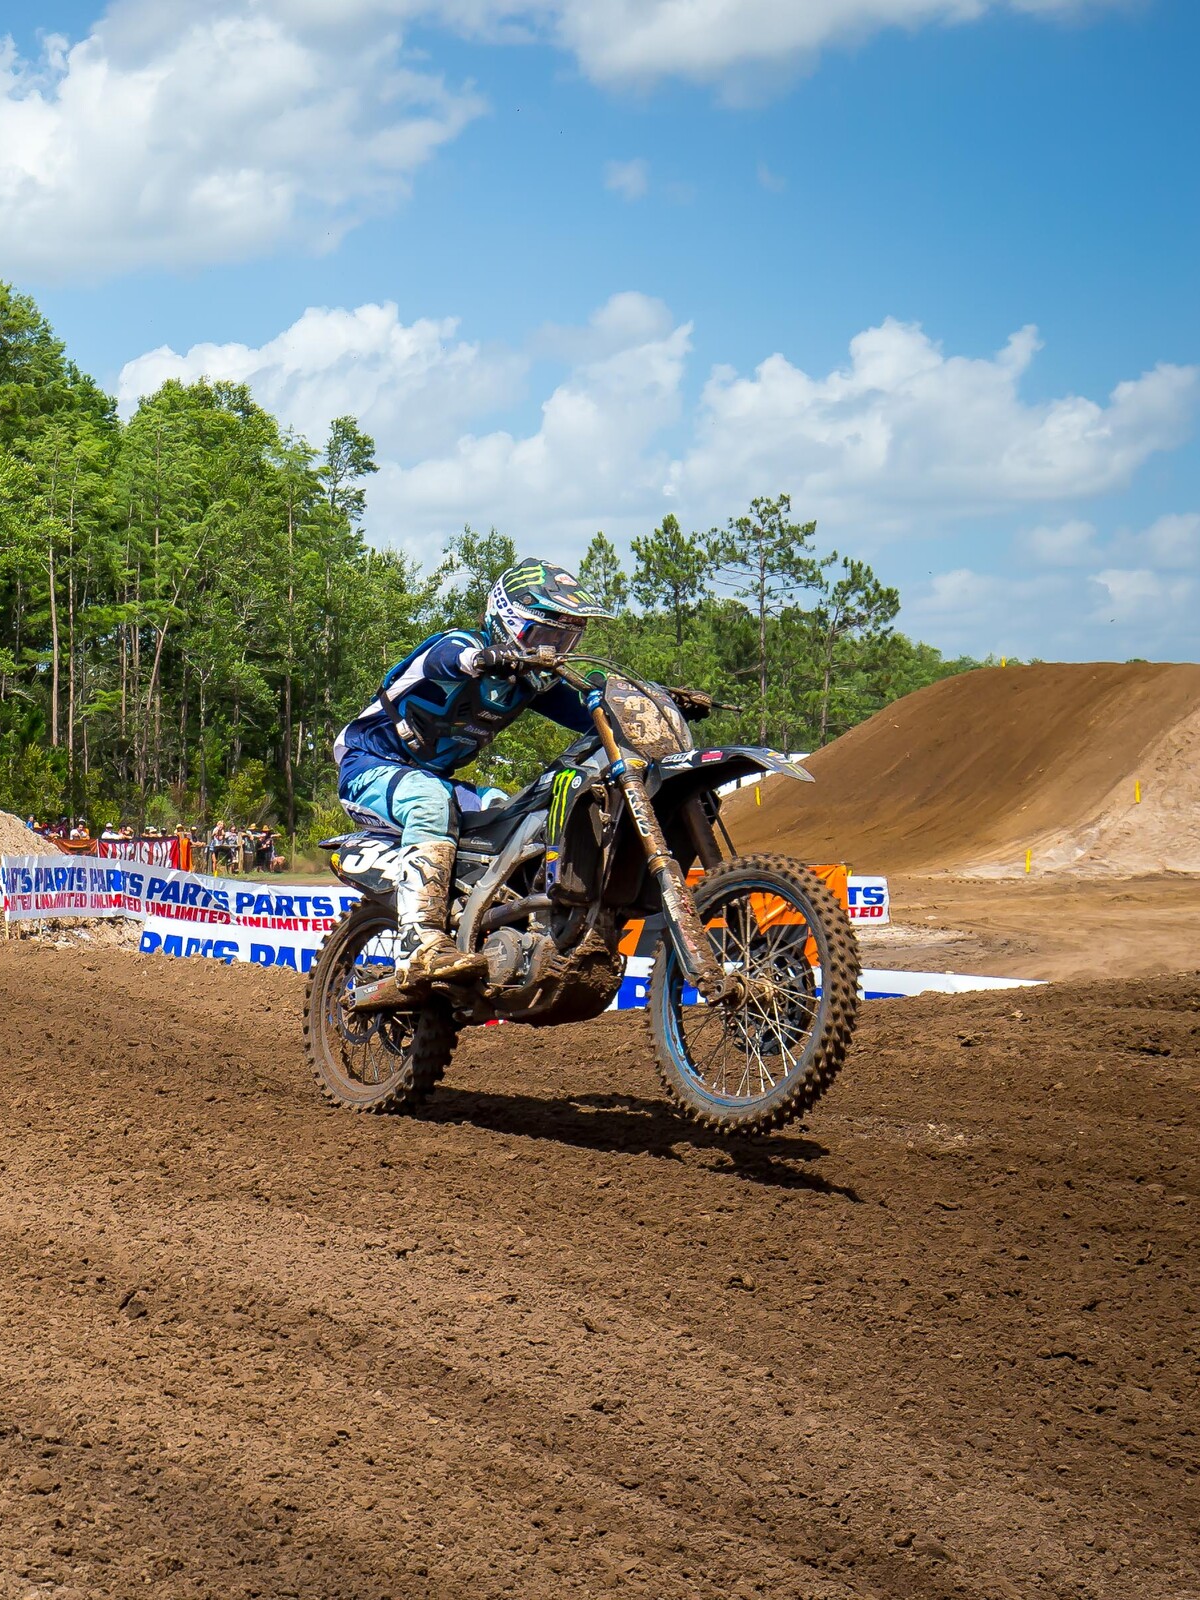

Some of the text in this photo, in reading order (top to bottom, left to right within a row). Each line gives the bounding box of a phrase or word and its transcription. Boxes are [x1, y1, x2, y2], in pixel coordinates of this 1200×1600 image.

[35, 867, 87, 893] PARTS
[89, 867, 144, 898] PARTS
[146, 877, 230, 912] PARTS
[235, 892, 336, 917] PARTS
[145, 900, 231, 926] UNLIMITED
